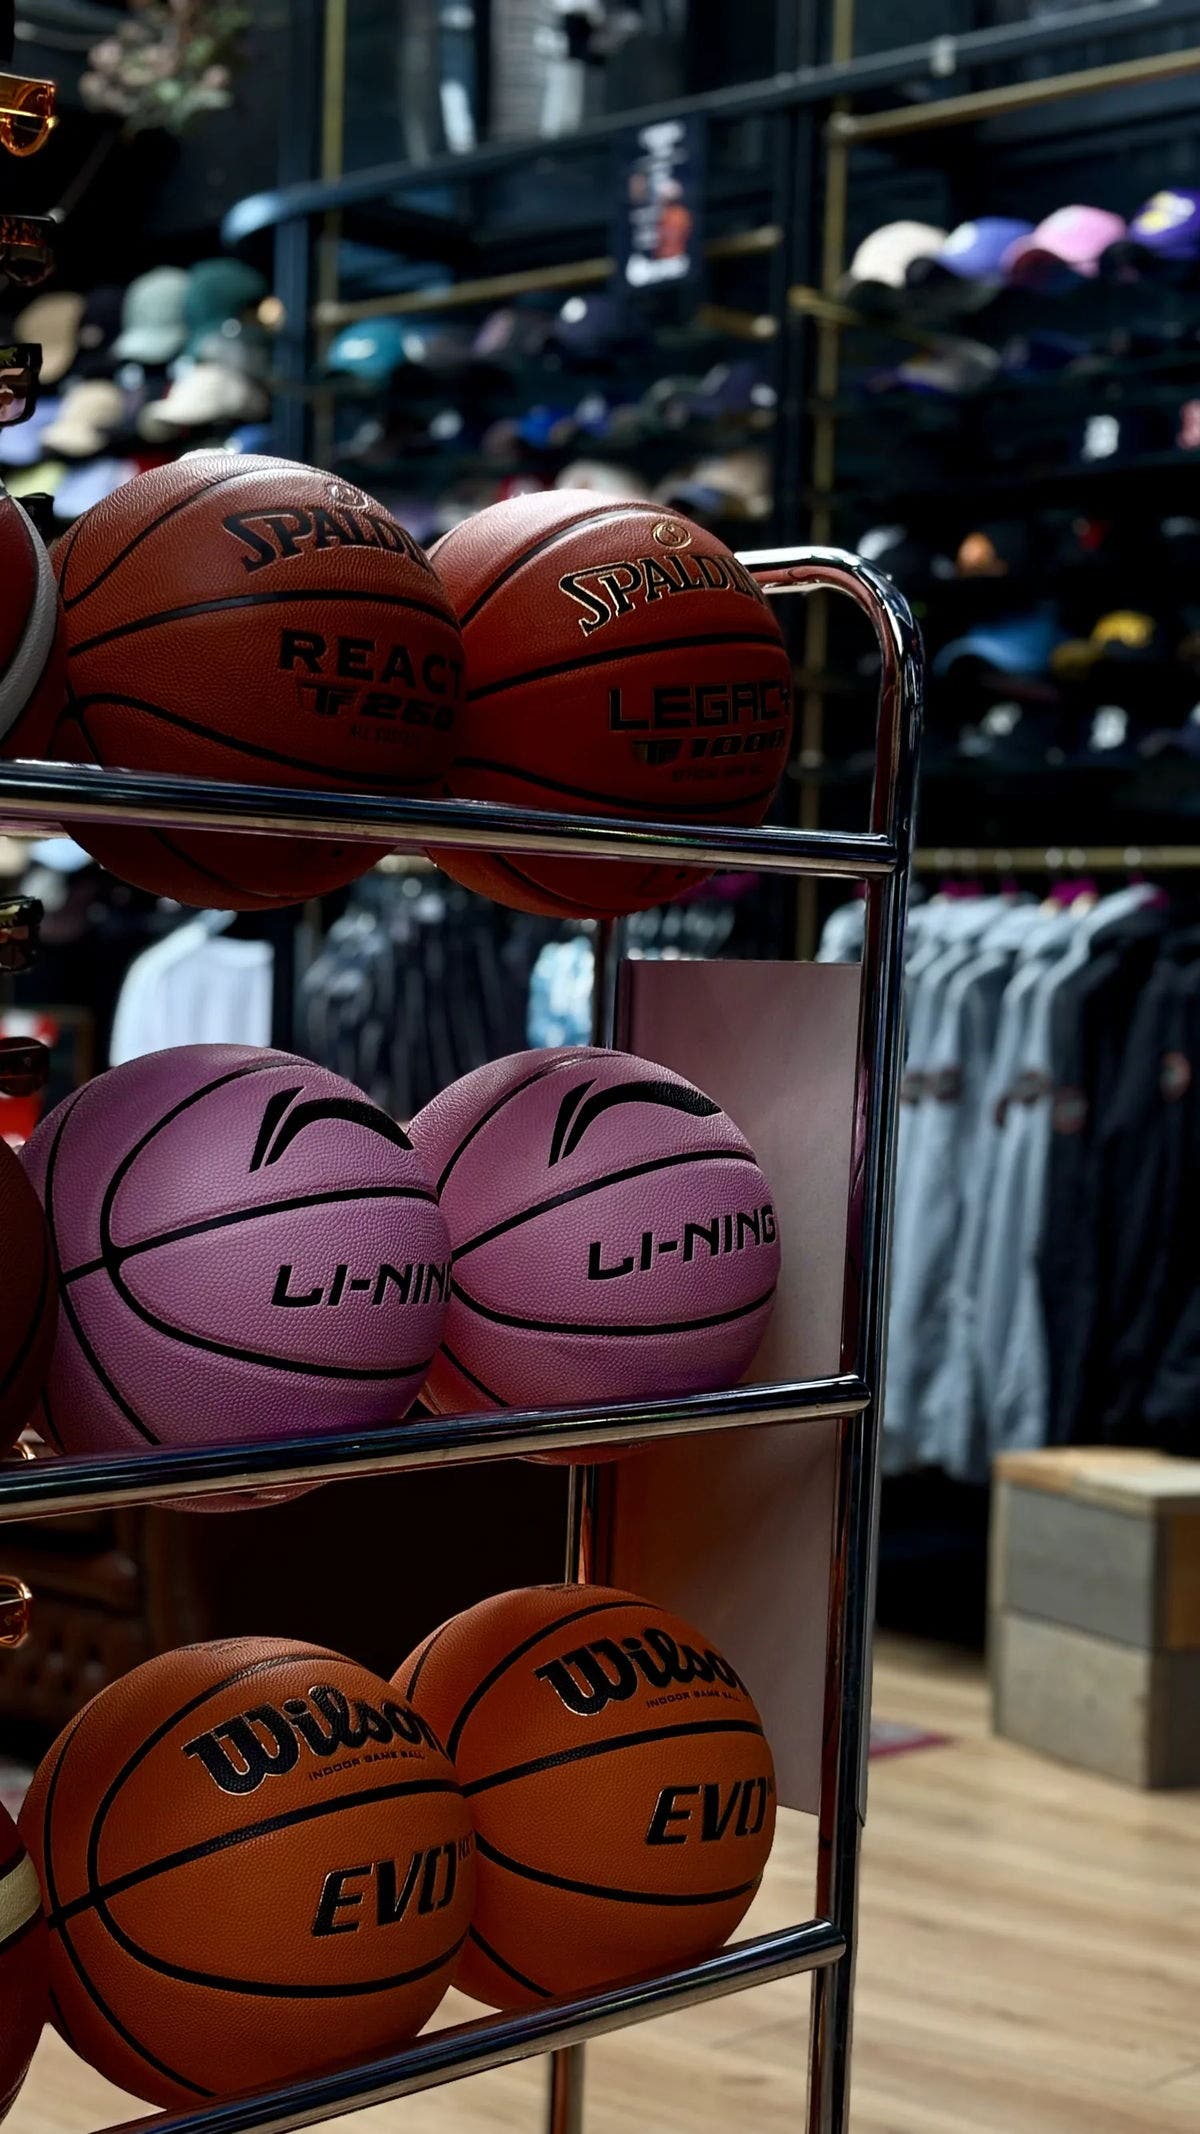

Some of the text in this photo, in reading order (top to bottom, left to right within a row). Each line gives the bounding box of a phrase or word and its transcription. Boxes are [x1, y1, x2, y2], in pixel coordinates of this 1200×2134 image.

[587, 1204, 776, 1281] LI-NING
[270, 1263, 452, 1308] LI-NIN
[645, 1691, 690, 1709] INDOOR
[308, 1750, 426, 1781] INDOOR GAME BALL
[646, 1776, 769, 1846] EVO
[311, 1840, 458, 1938] EVO
